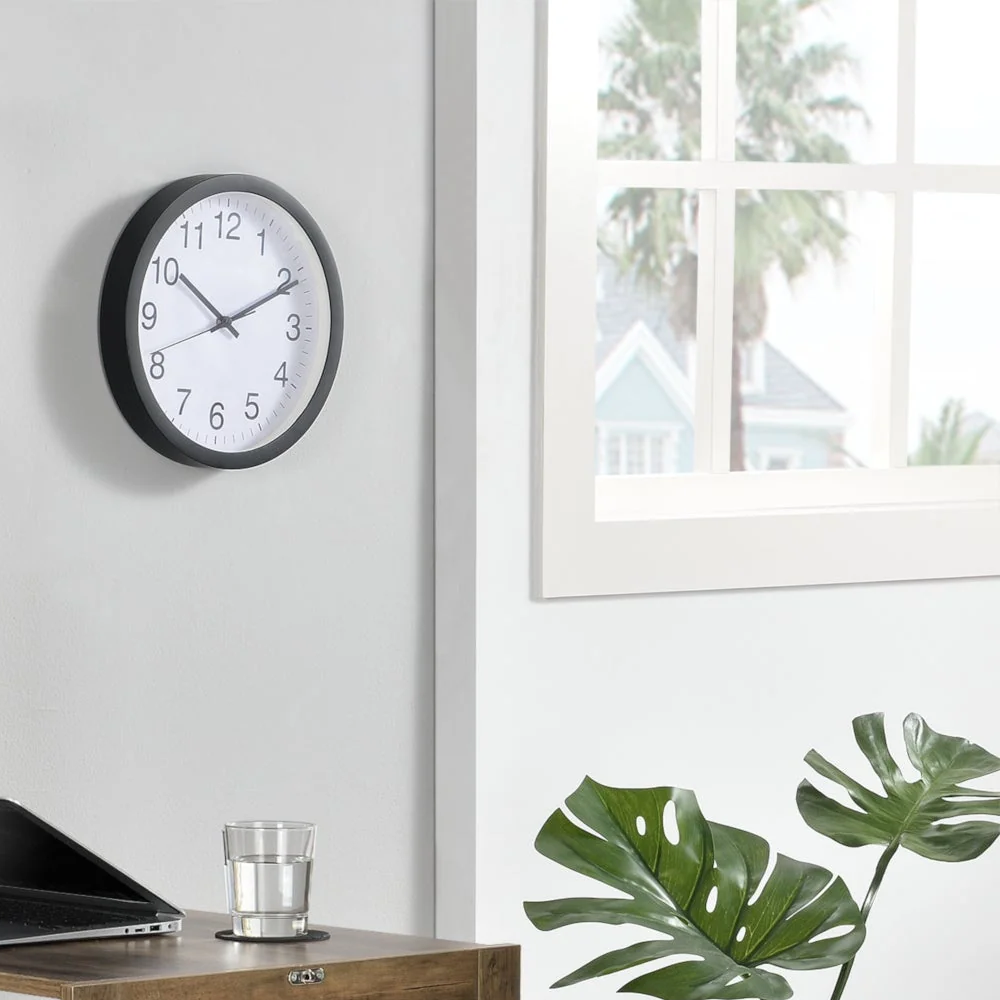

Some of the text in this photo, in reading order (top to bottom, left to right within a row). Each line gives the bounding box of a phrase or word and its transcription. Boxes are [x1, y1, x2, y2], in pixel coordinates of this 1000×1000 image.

[179, 220, 203, 250] 11
[214, 210, 241, 241] 12
[256, 228, 266, 256] 1
[151, 256, 180, 286] 10
[276, 267, 292, 296] 2
[141, 301, 157, 330] 9
[285, 313, 301, 342] 3
[149, 350, 165, 380] 8
[273, 361, 289, 388] 4
[176, 388, 192, 415] 7
[209, 401, 225, 430] 6
[244, 392, 260, 420] 5
